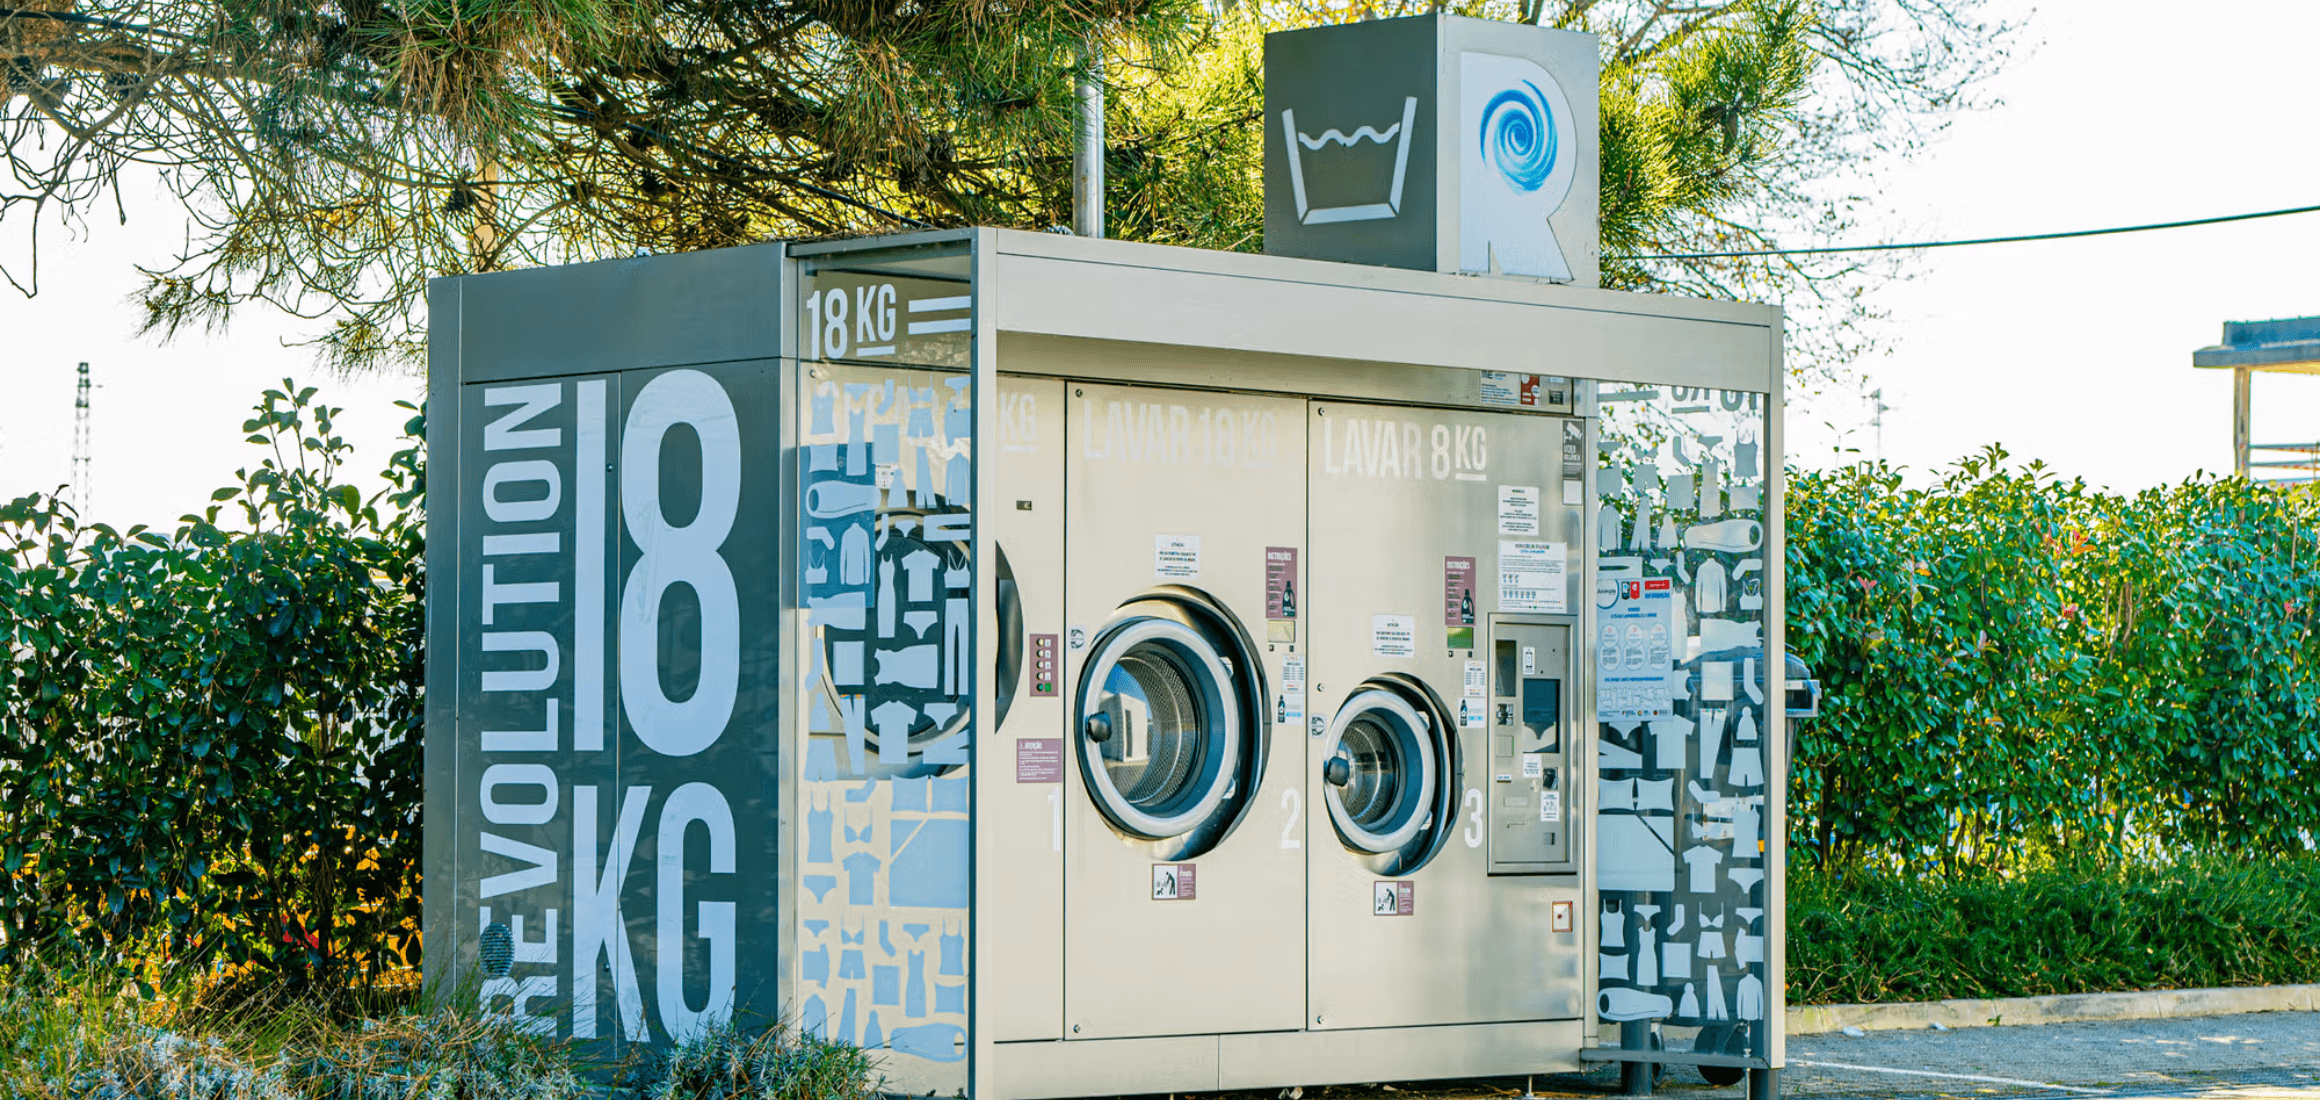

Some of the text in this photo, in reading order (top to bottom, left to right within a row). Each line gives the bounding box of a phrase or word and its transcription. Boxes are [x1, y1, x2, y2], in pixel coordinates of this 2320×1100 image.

[806, 283, 896, 360] 18 KG
[1000, 392, 1036, 441] KG
[1083, 400, 1191, 464] LAVAR
[1324, 417, 1487, 481] LAVAR 8 KG
[573, 369, 741, 757] 18
[479, 382, 562, 1038] REVOLUTION
[1046, 786, 1060, 851] 1
[1279, 787, 1301, 850] 2
[1463, 787, 1484, 849] 3
[573, 781, 737, 1044] KG
